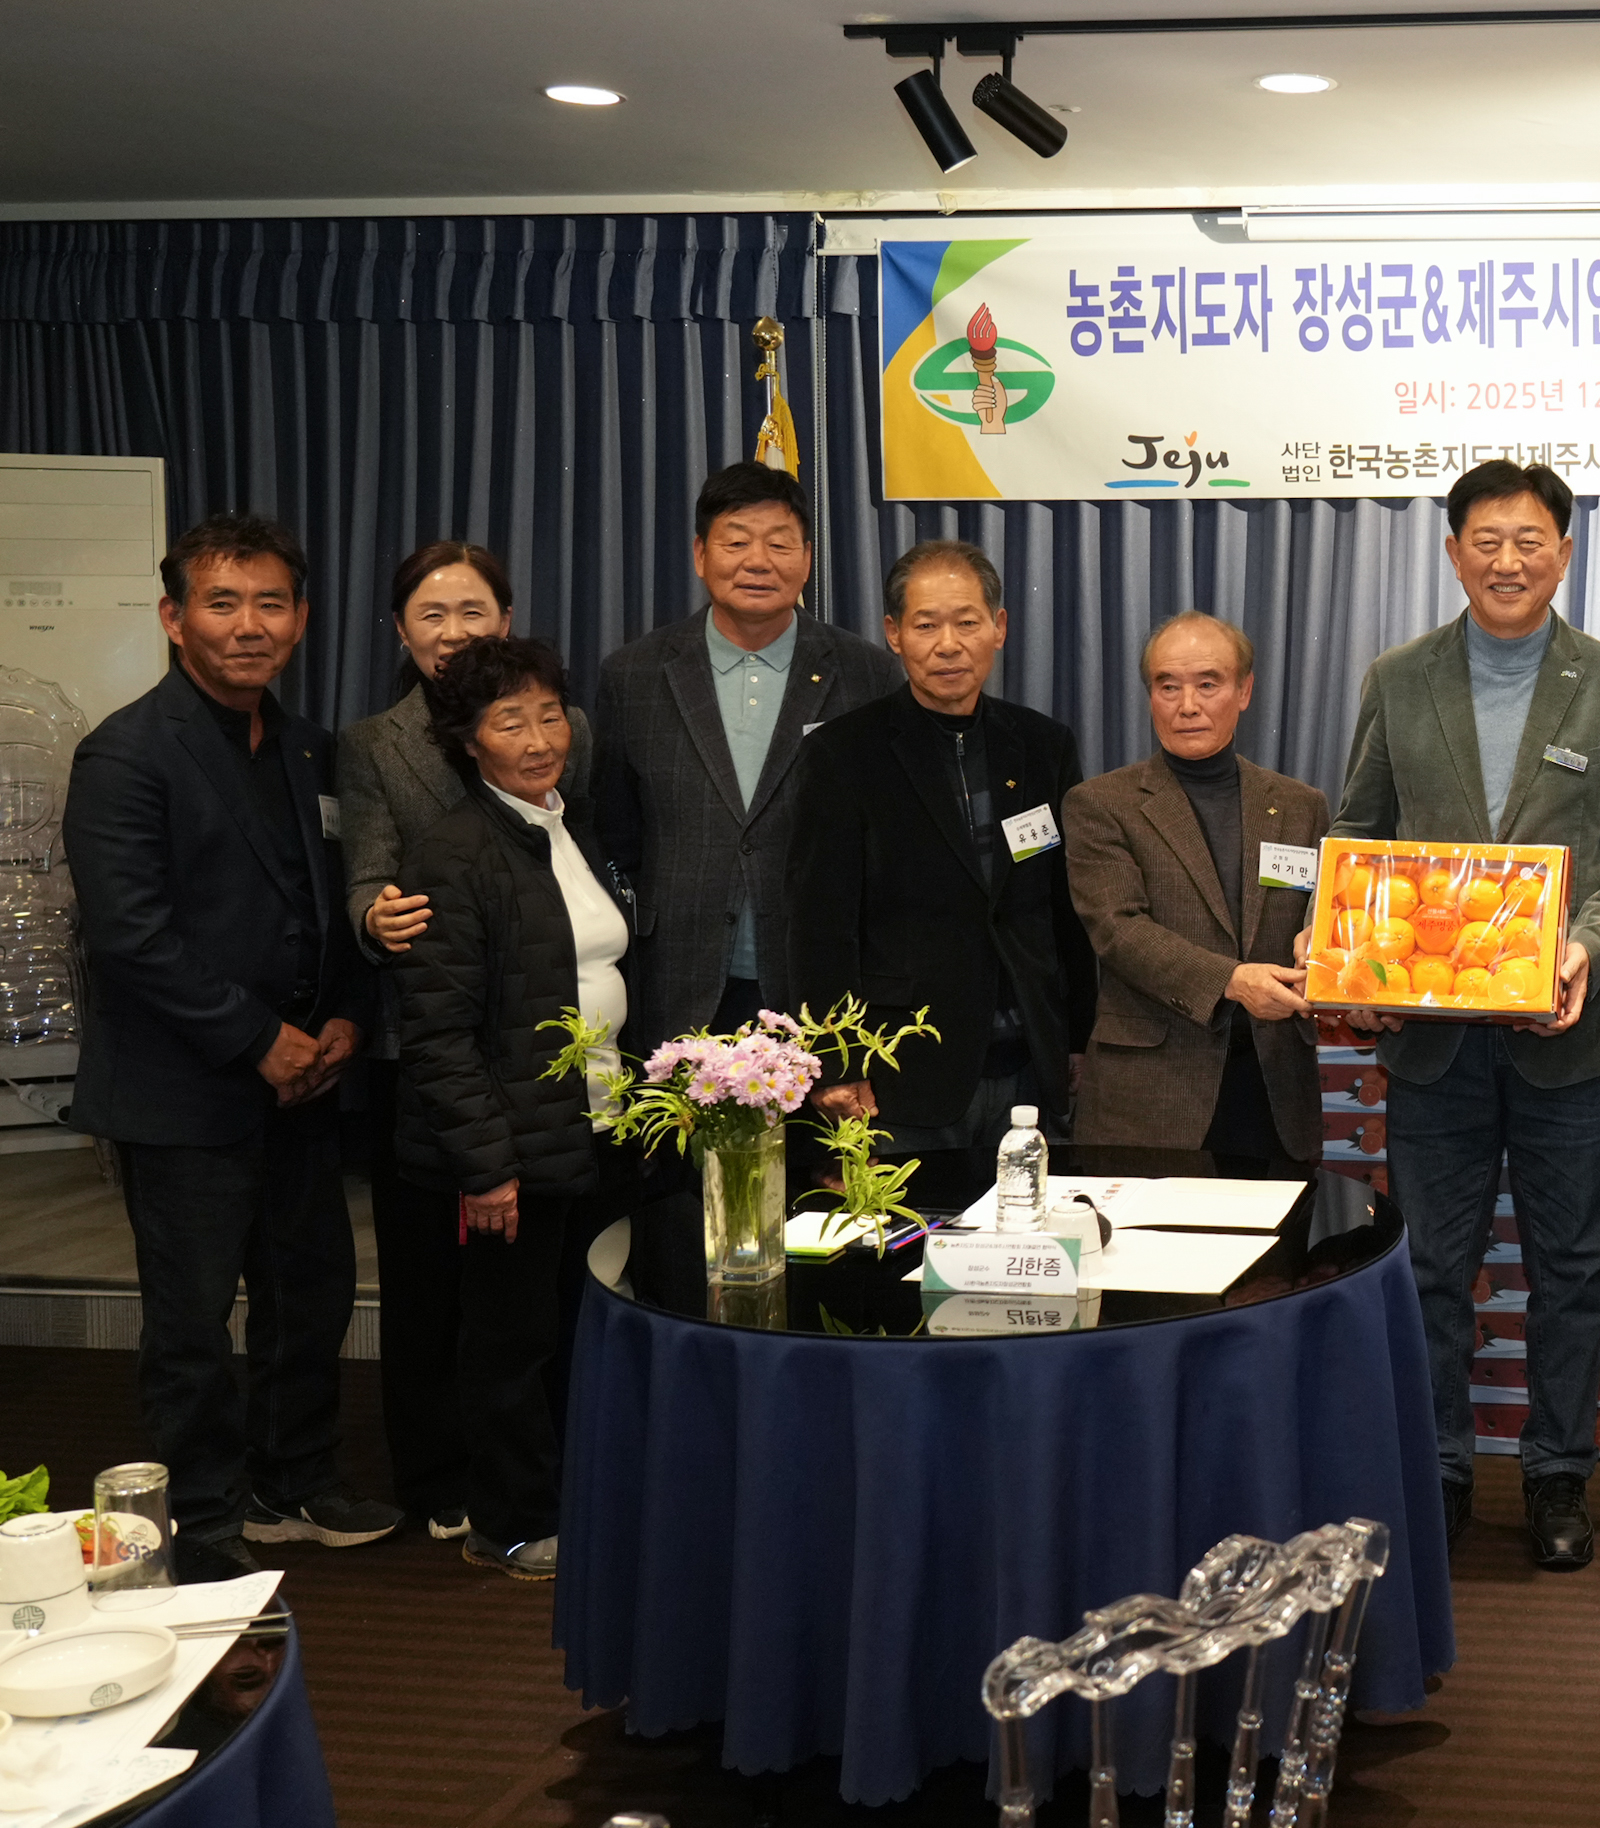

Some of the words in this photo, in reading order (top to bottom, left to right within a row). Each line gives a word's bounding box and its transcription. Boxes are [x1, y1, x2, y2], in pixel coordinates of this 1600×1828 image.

[1066, 265, 1272, 356] 농촌지도자
[1394, 379, 1458, 415] 일시:
[1466, 381, 1563, 413] 2025년
[1121, 431, 1230, 489] Jeju
[1281, 442, 1321, 461] 사단
[1281, 463, 1322, 483] 법인
[1005, 1257, 1061, 1277] 김한종
